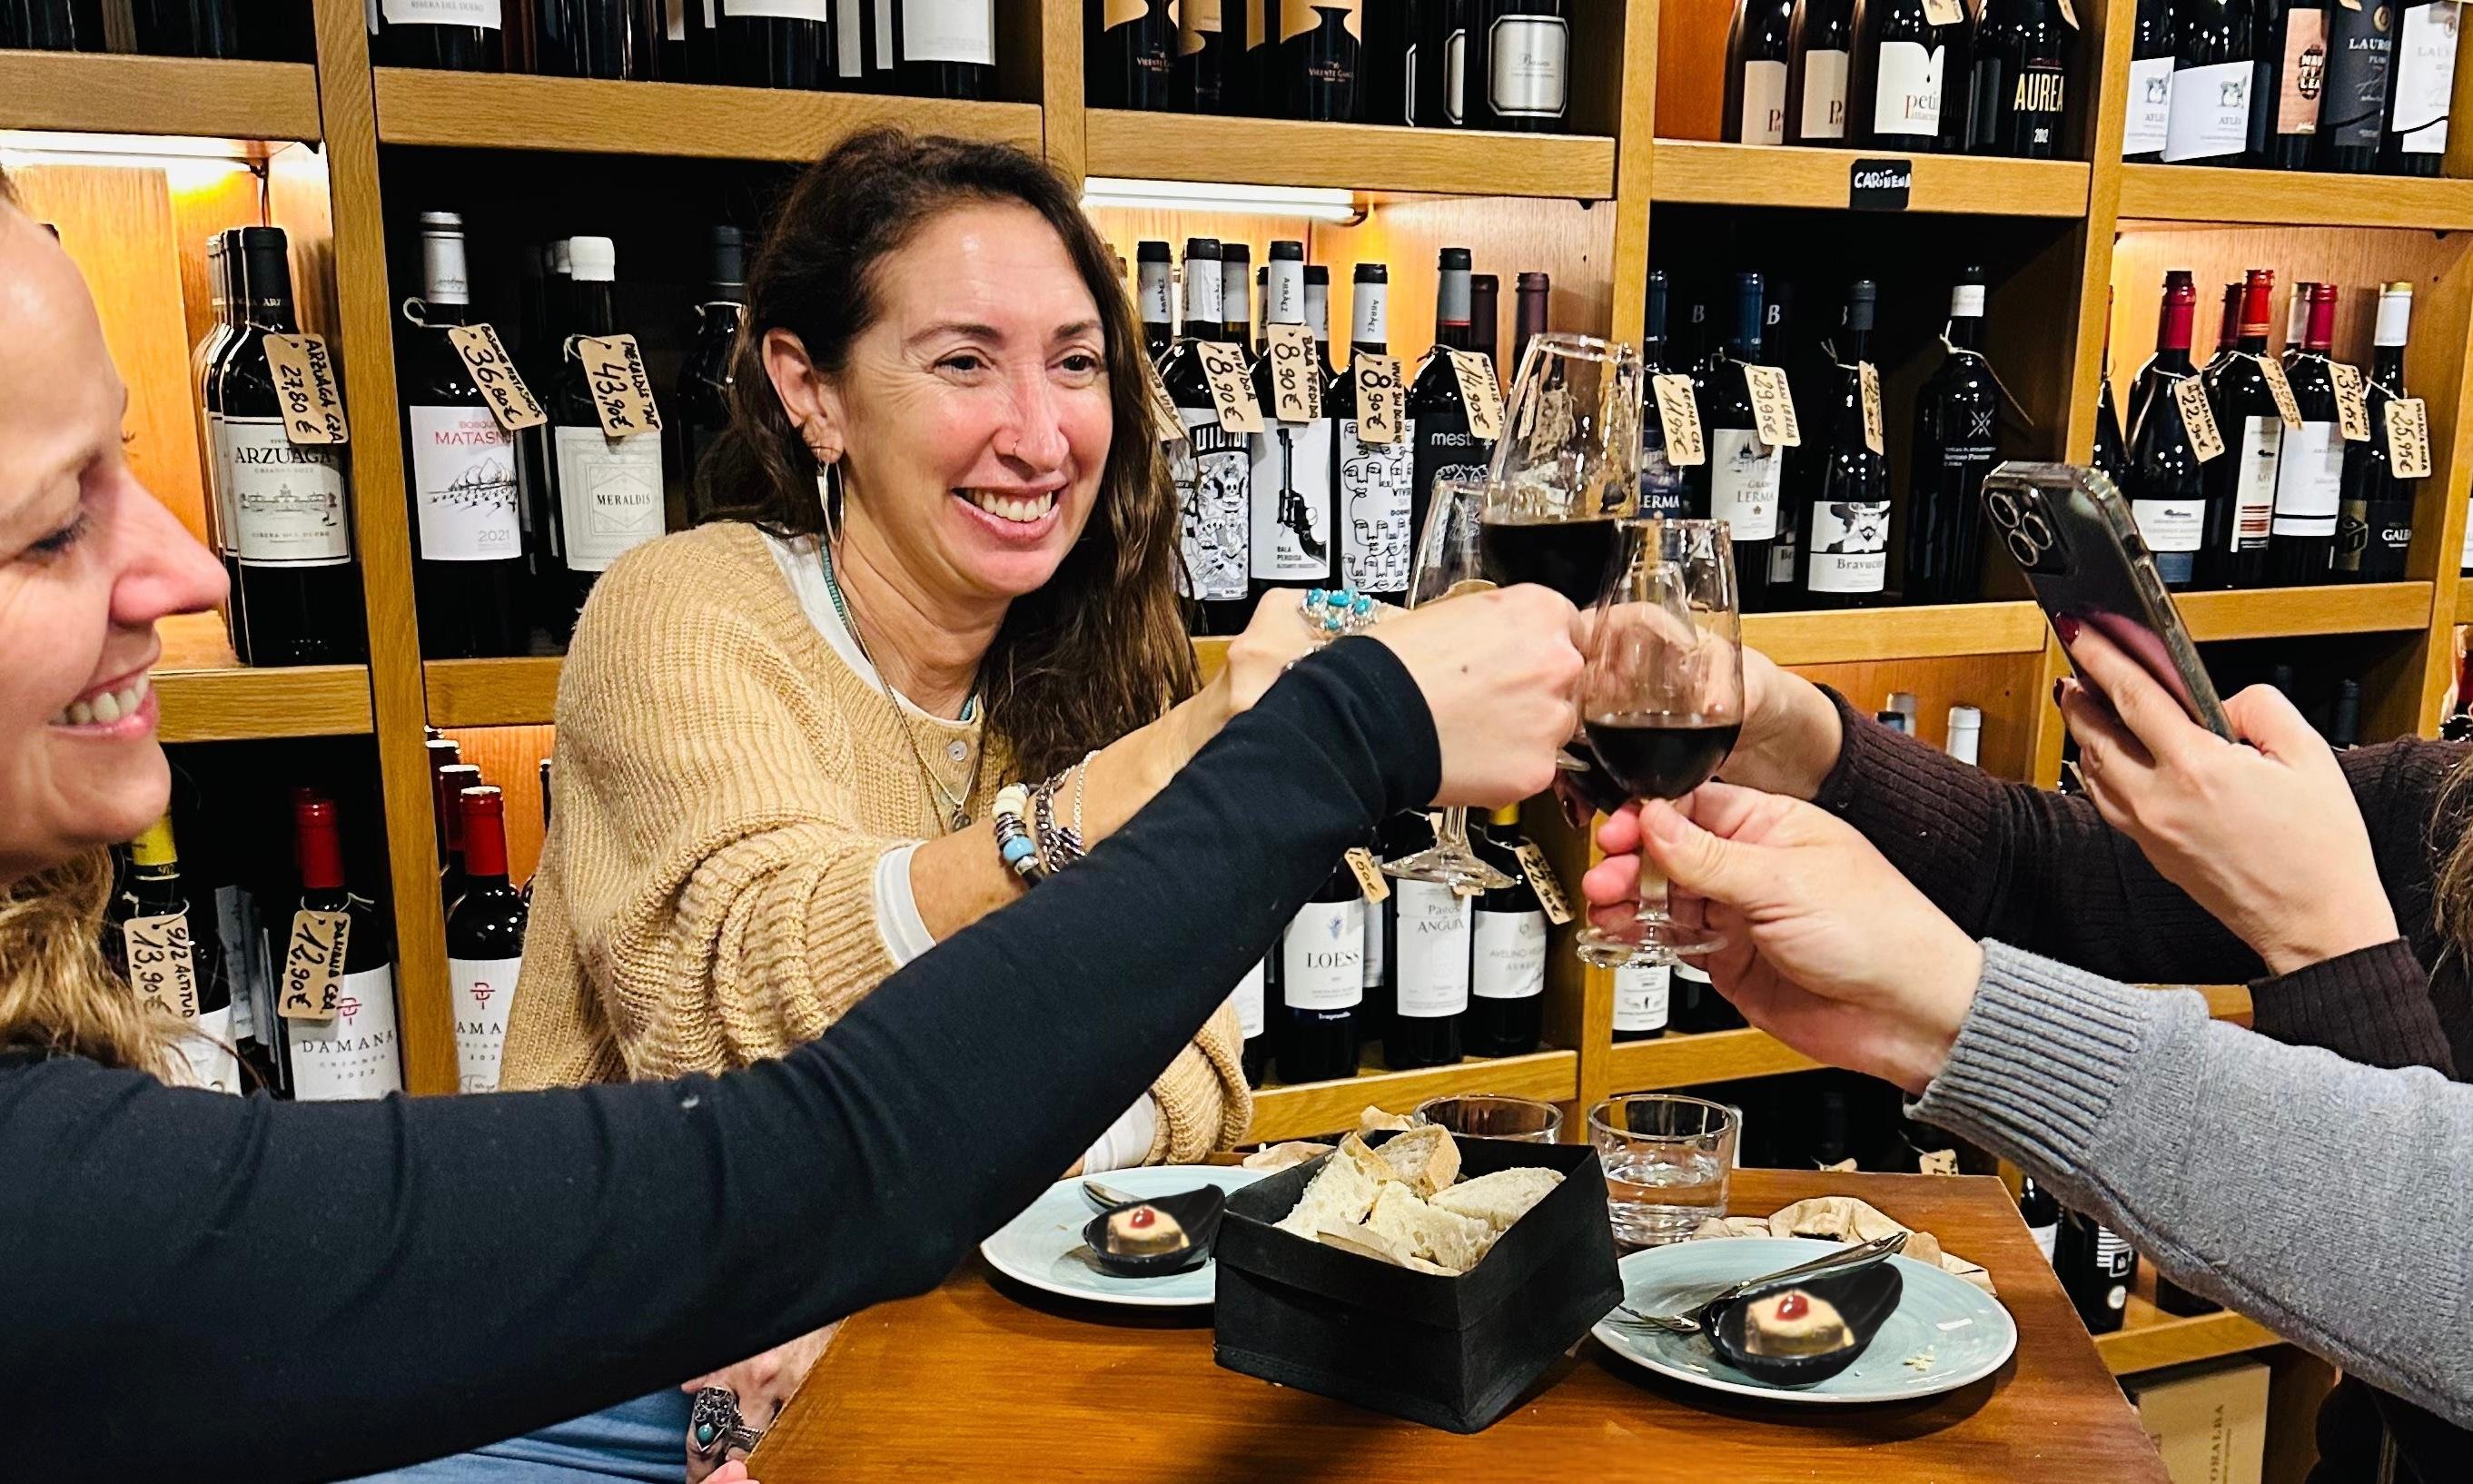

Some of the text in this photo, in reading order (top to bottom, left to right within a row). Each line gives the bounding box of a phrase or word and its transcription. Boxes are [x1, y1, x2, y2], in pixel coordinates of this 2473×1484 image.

[2013, 73, 2064, 113] AUREA
[1766, 304, 1781, 325] B
[304, 337, 337, 409] ARZUAGA
[1231, 351, 1257, 402] VIVIDOR
[592, 362, 636, 430] 43,90€
[459, 420, 497, 430] BOSQU
[234, 446, 331, 465] ARZUAGA
[596, 493, 652, 507] MERALDIS
[1642, 493, 1680, 510] ERMA
[478, 529, 510, 543] 2021
[287, 922, 329, 1010] 12,90€
[1307, 951, 1360, 969] LOESS
[457, 1021, 502, 1035] AMA
[302, 1029, 393, 1054] DAMANA
